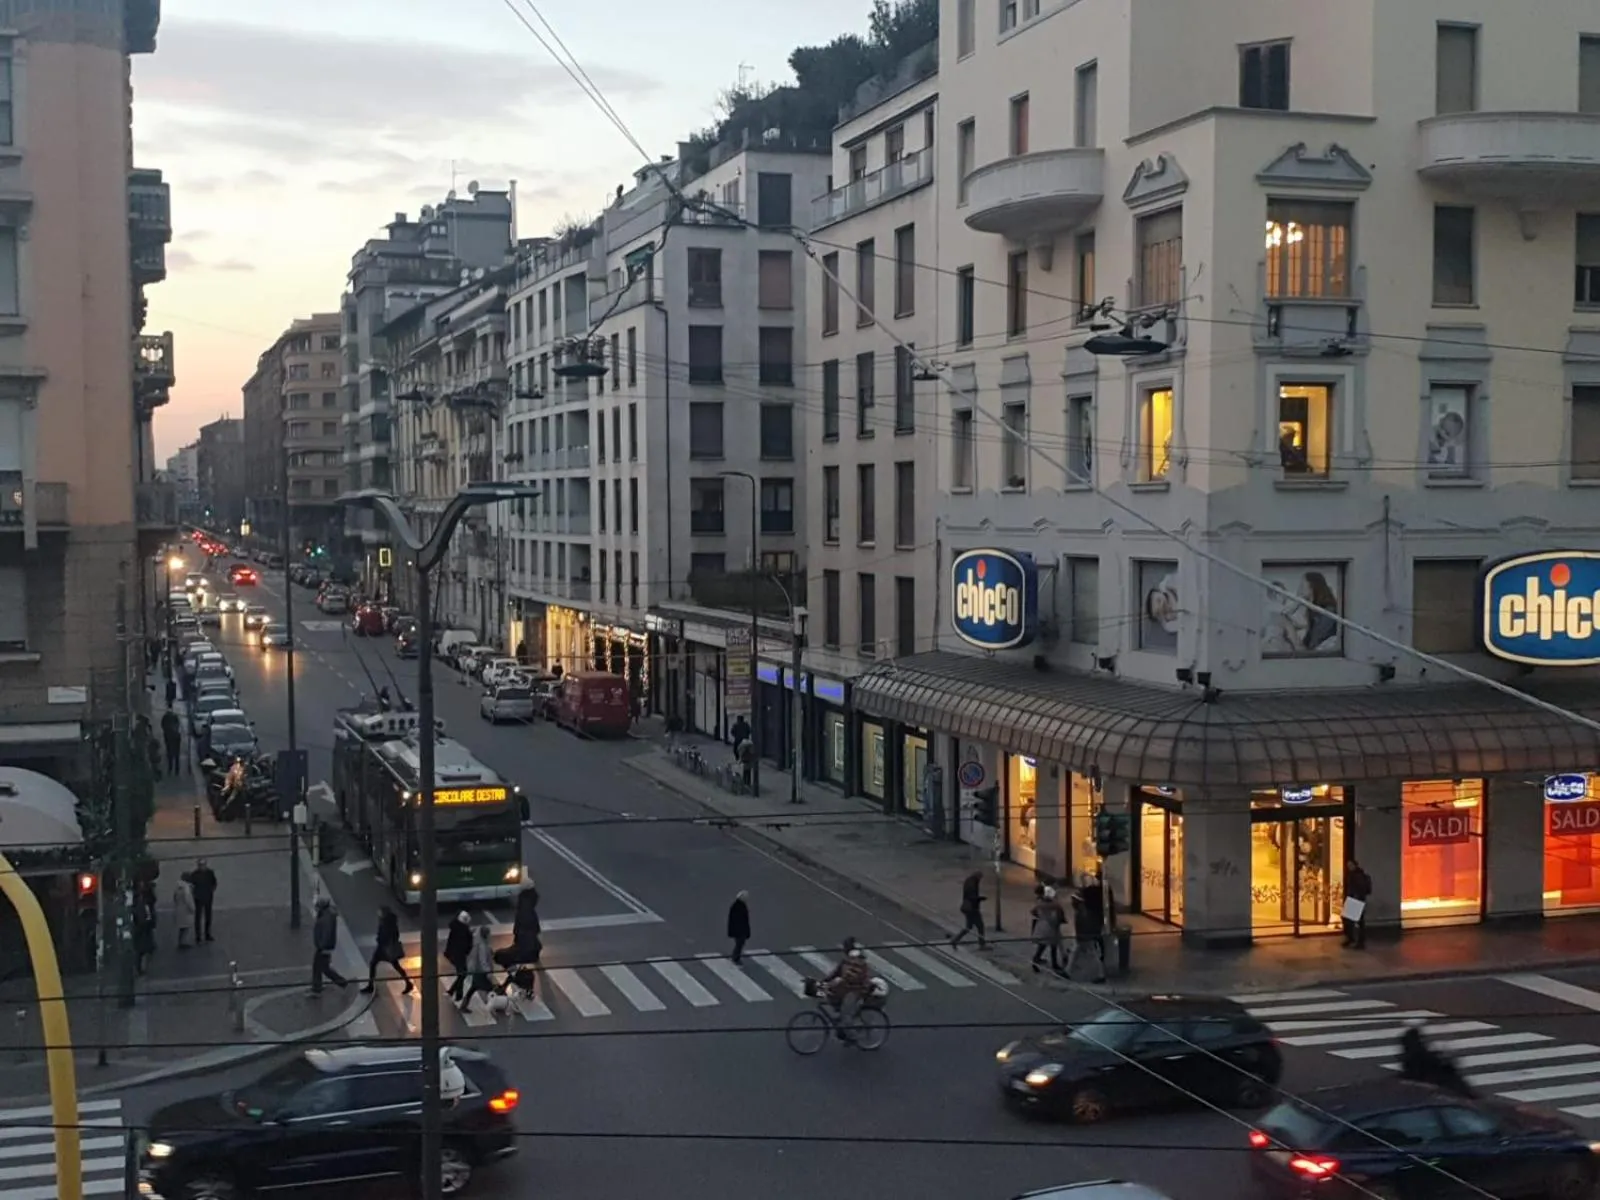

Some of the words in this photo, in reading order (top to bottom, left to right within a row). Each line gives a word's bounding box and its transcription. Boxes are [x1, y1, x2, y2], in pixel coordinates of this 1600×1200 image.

[957, 559, 1019, 626] chicco
[1499, 563, 1600, 640] chic
[1410, 816, 1468, 839] SALDI
